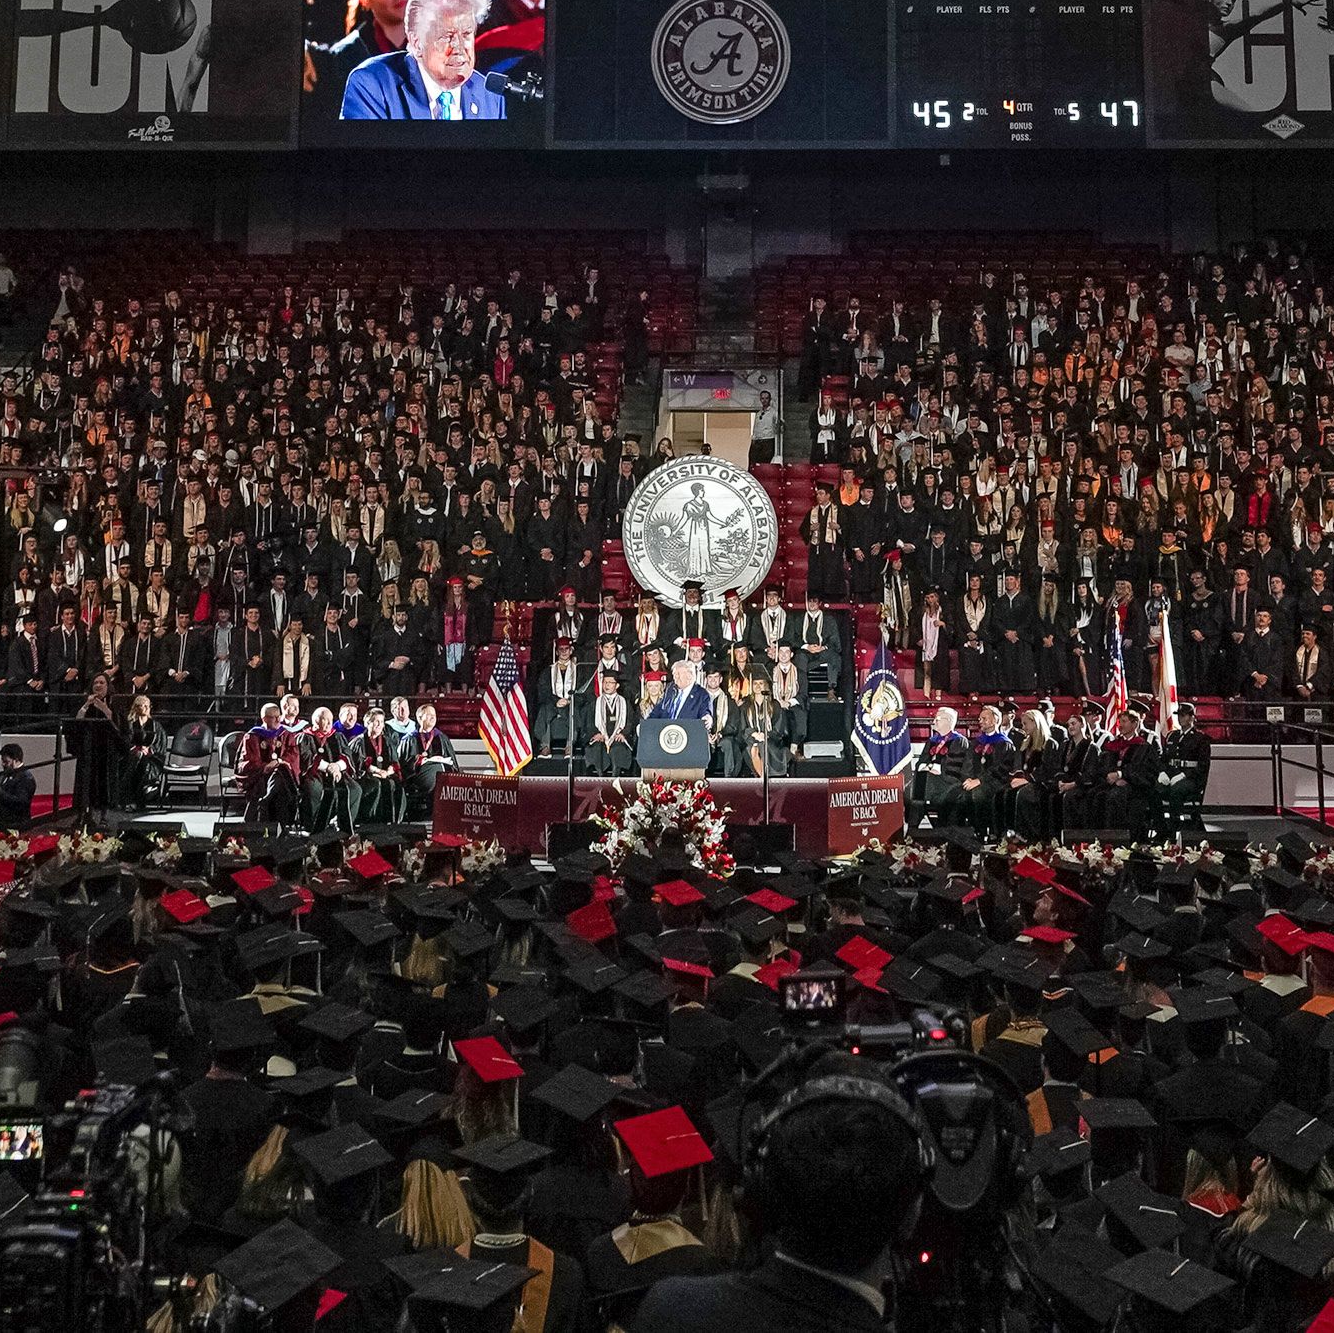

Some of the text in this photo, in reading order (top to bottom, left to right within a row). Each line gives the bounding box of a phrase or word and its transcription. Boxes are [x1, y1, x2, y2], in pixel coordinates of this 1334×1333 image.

[936, 5, 963, 14] PLAYER
[979, 5, 992, 14] FLS
[996, 5, 1010, 14] PTS
[1058, 5, 1085, 14] PLAYER
[1102, 5, 1115, 14] FLS
[1120, 5, 1134, 14] PTS
[668, 1, 774, 50] ALABAMA
[667, 61, 774, 110] CRIMSON TIDE
[913, 99, 1139, 128] 45 2 TOL 4 QTR TOL 5 47
[1009, 122, 1033, 131] BONUS
[1011, 134, 1032, 142] POSS.
[683, 374, 696, 386] W
[630, 464, 769, 568] THE UNIVERSITY OF ALABAMA
[439, 786, 517, 805] AMERICAN DREAM
[829, 788, 898, 808] AMERICAN DREAM
[464, 803, 492, 817] IS BACK
[853, 806, 877, 820] IS BACK
